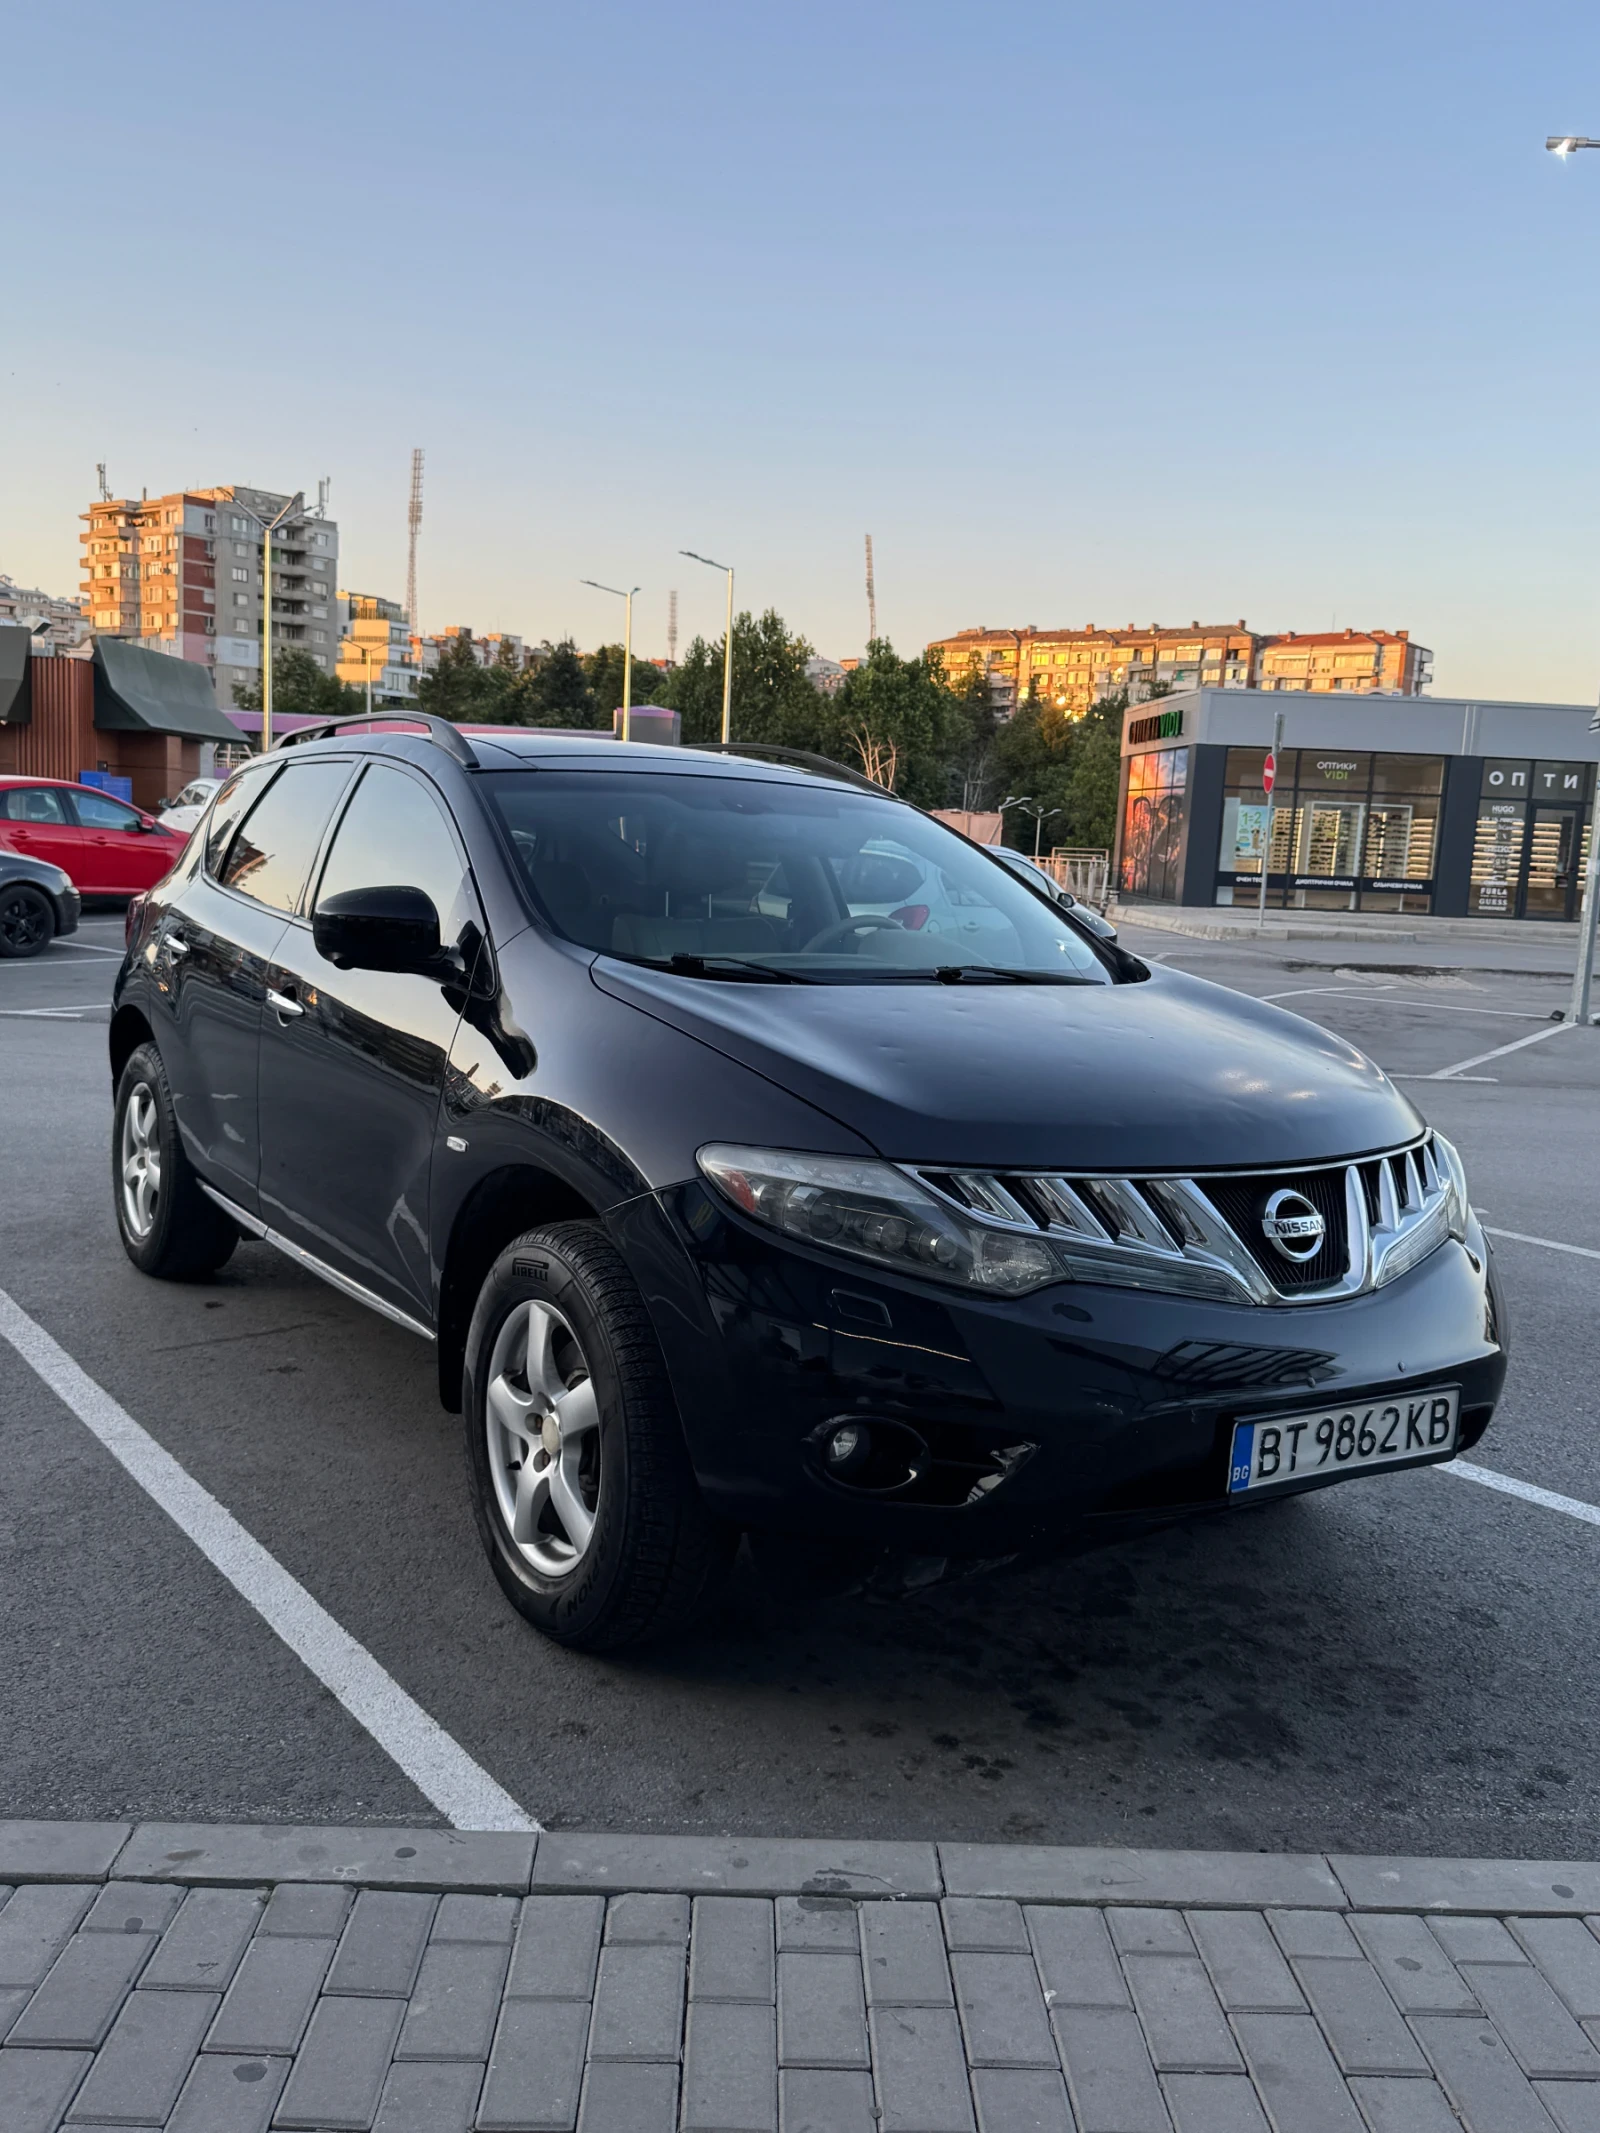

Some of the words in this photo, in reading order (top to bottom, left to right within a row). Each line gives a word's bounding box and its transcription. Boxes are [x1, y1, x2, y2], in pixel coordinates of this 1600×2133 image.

[1317, 761, 1357, 770] ОПТИКИ
[1324, 770, 1348, 780] VIDI
[1492, 805, 1515, 814] HUGO
[1481, 887, 1507, 895] FURLA
[1275, 1220, 1324, 1234] NISSAN
[512, 1258, 550, 1282] PIRELLI
[1232, 1465, 1249, 1482] BG
